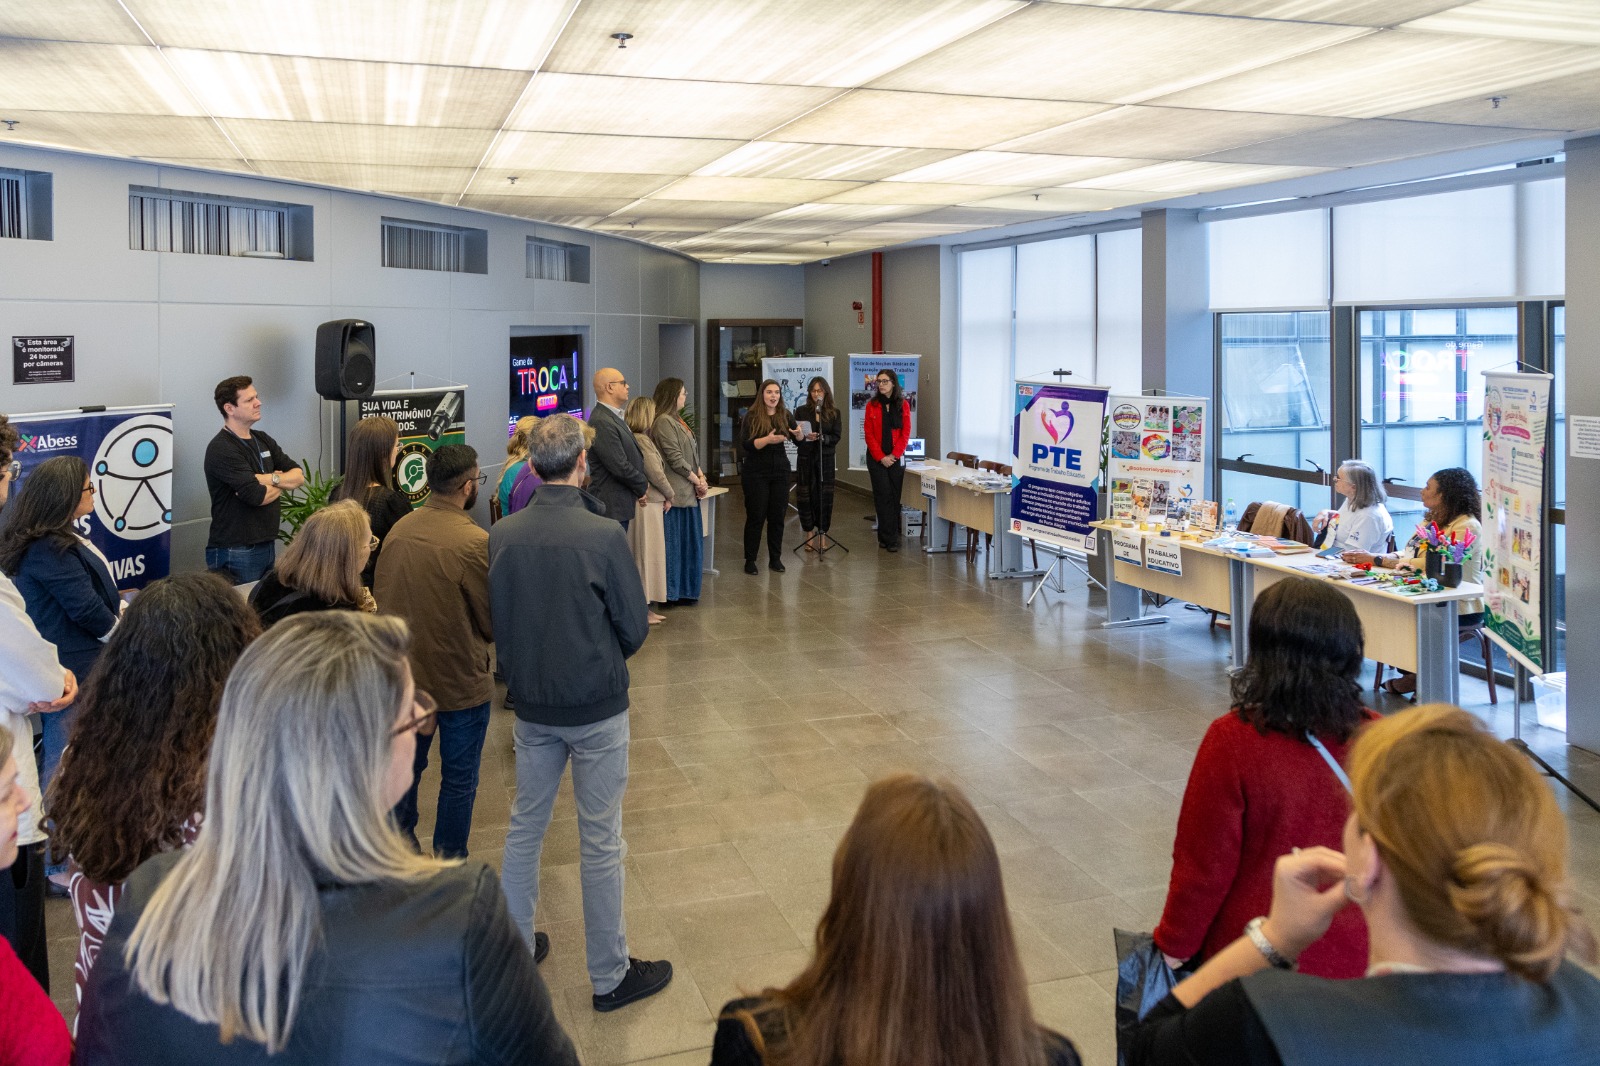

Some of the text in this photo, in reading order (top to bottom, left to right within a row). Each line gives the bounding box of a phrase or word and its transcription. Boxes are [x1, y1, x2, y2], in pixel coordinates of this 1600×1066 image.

[512, 358, 526, 366] Game
[362, 400, 410, 410] SUA VIDA E
[37, 434, 78, 449] Abess
[1032, 443, 1082, 471] PTE
[1050, 468, 1066, 476] Trabalho
[1066, 470, 1086, 478] Educativo
[1114, 540, 1138, 550] PROGRAMA
[1148, 548, 1178, 558] TRABALHO
[1148, 558, 1178, 568] EDUCATIVO
